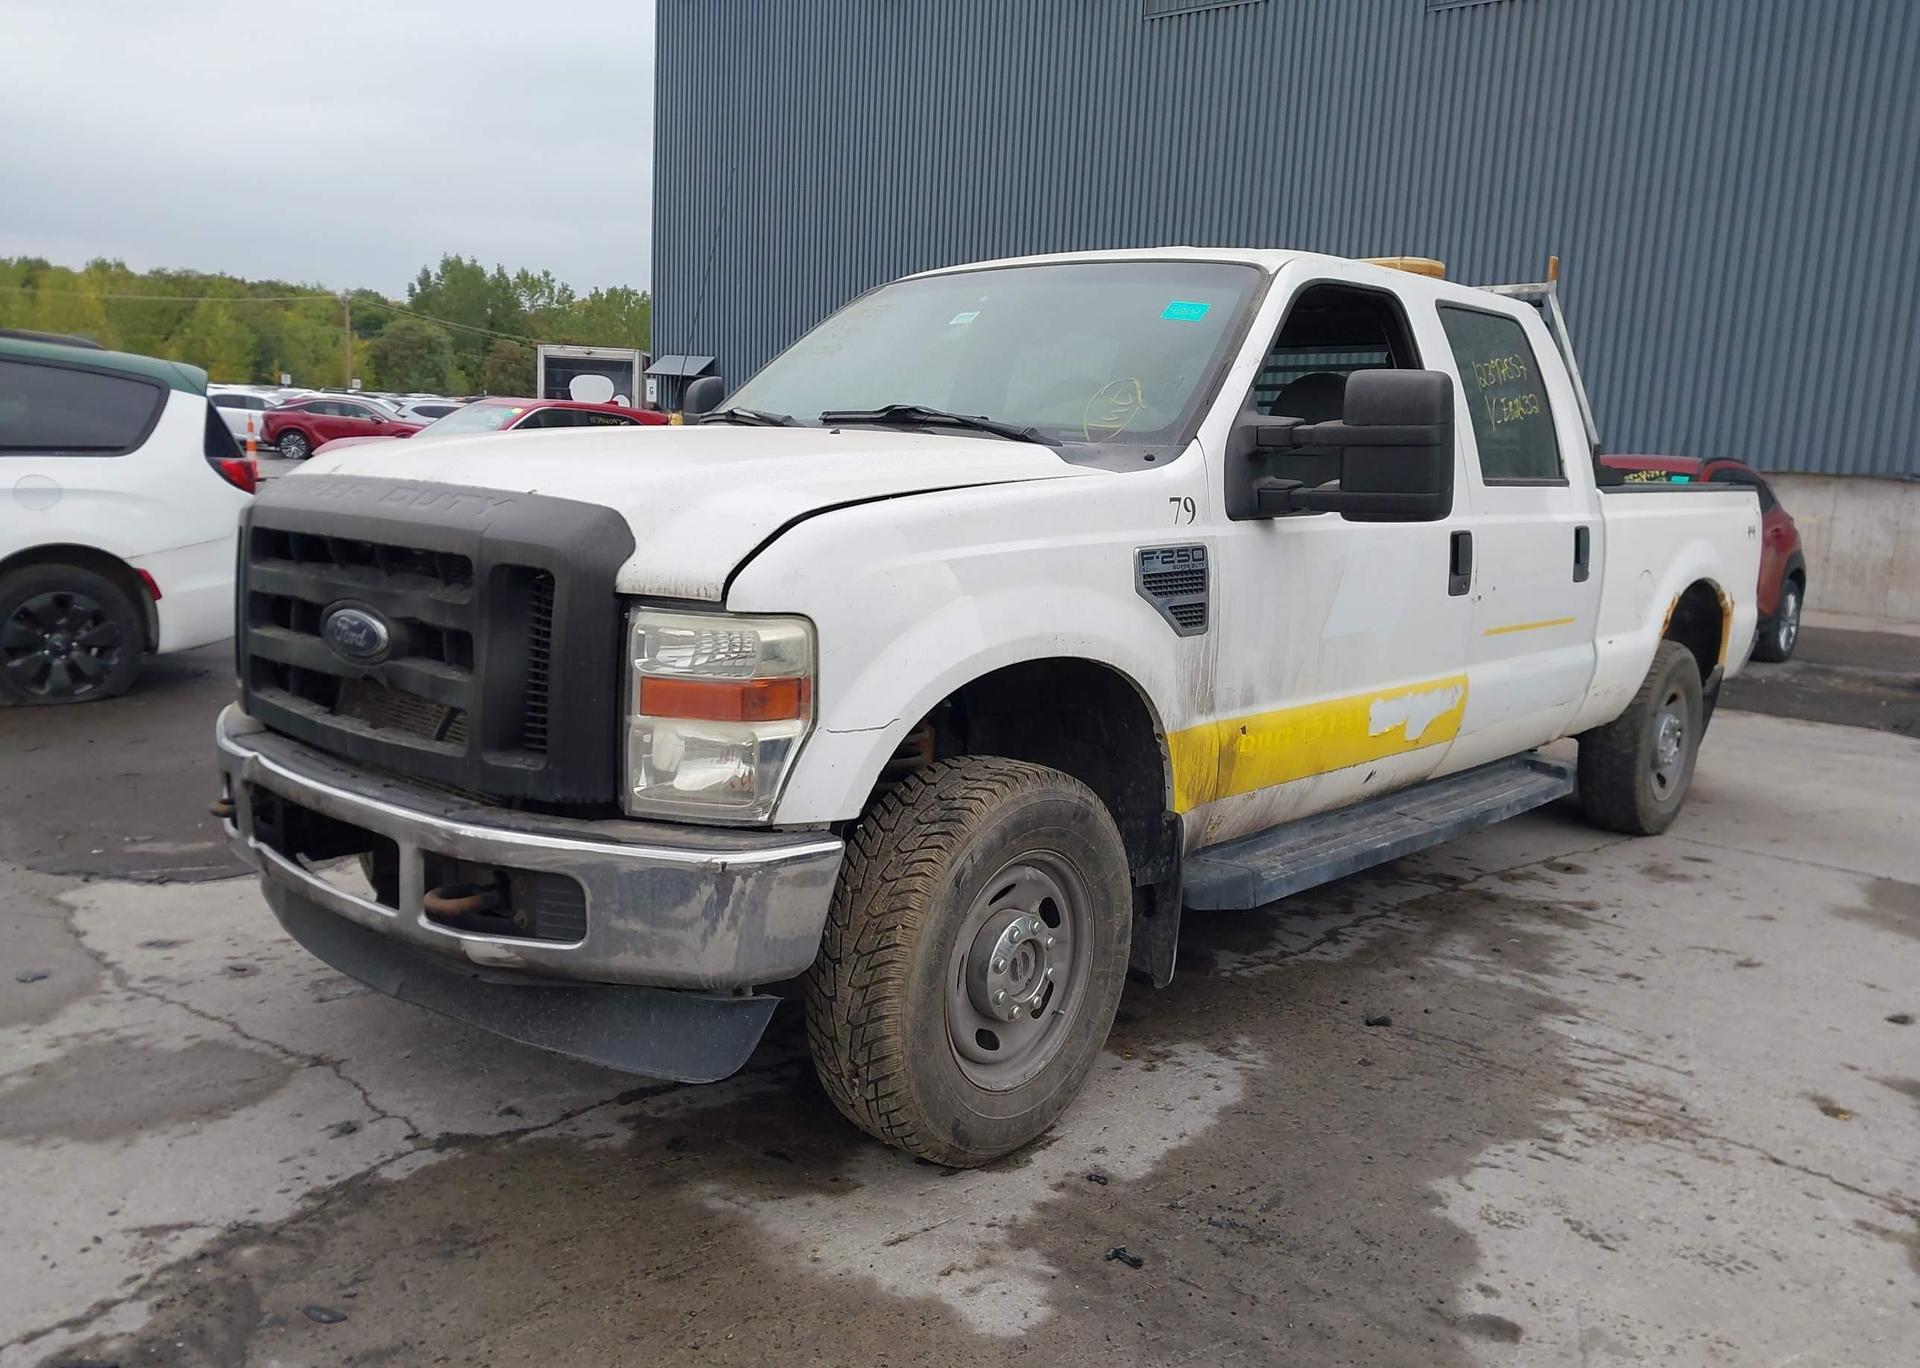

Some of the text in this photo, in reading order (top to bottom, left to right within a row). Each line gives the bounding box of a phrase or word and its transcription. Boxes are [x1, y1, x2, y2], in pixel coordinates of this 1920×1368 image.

[377, 486, 517, 518] DUTY
[1169, 497, 1196, 525] 79
[1141, 547, 1205, 567] F-250
[335, 616, 368, 647] Ford
